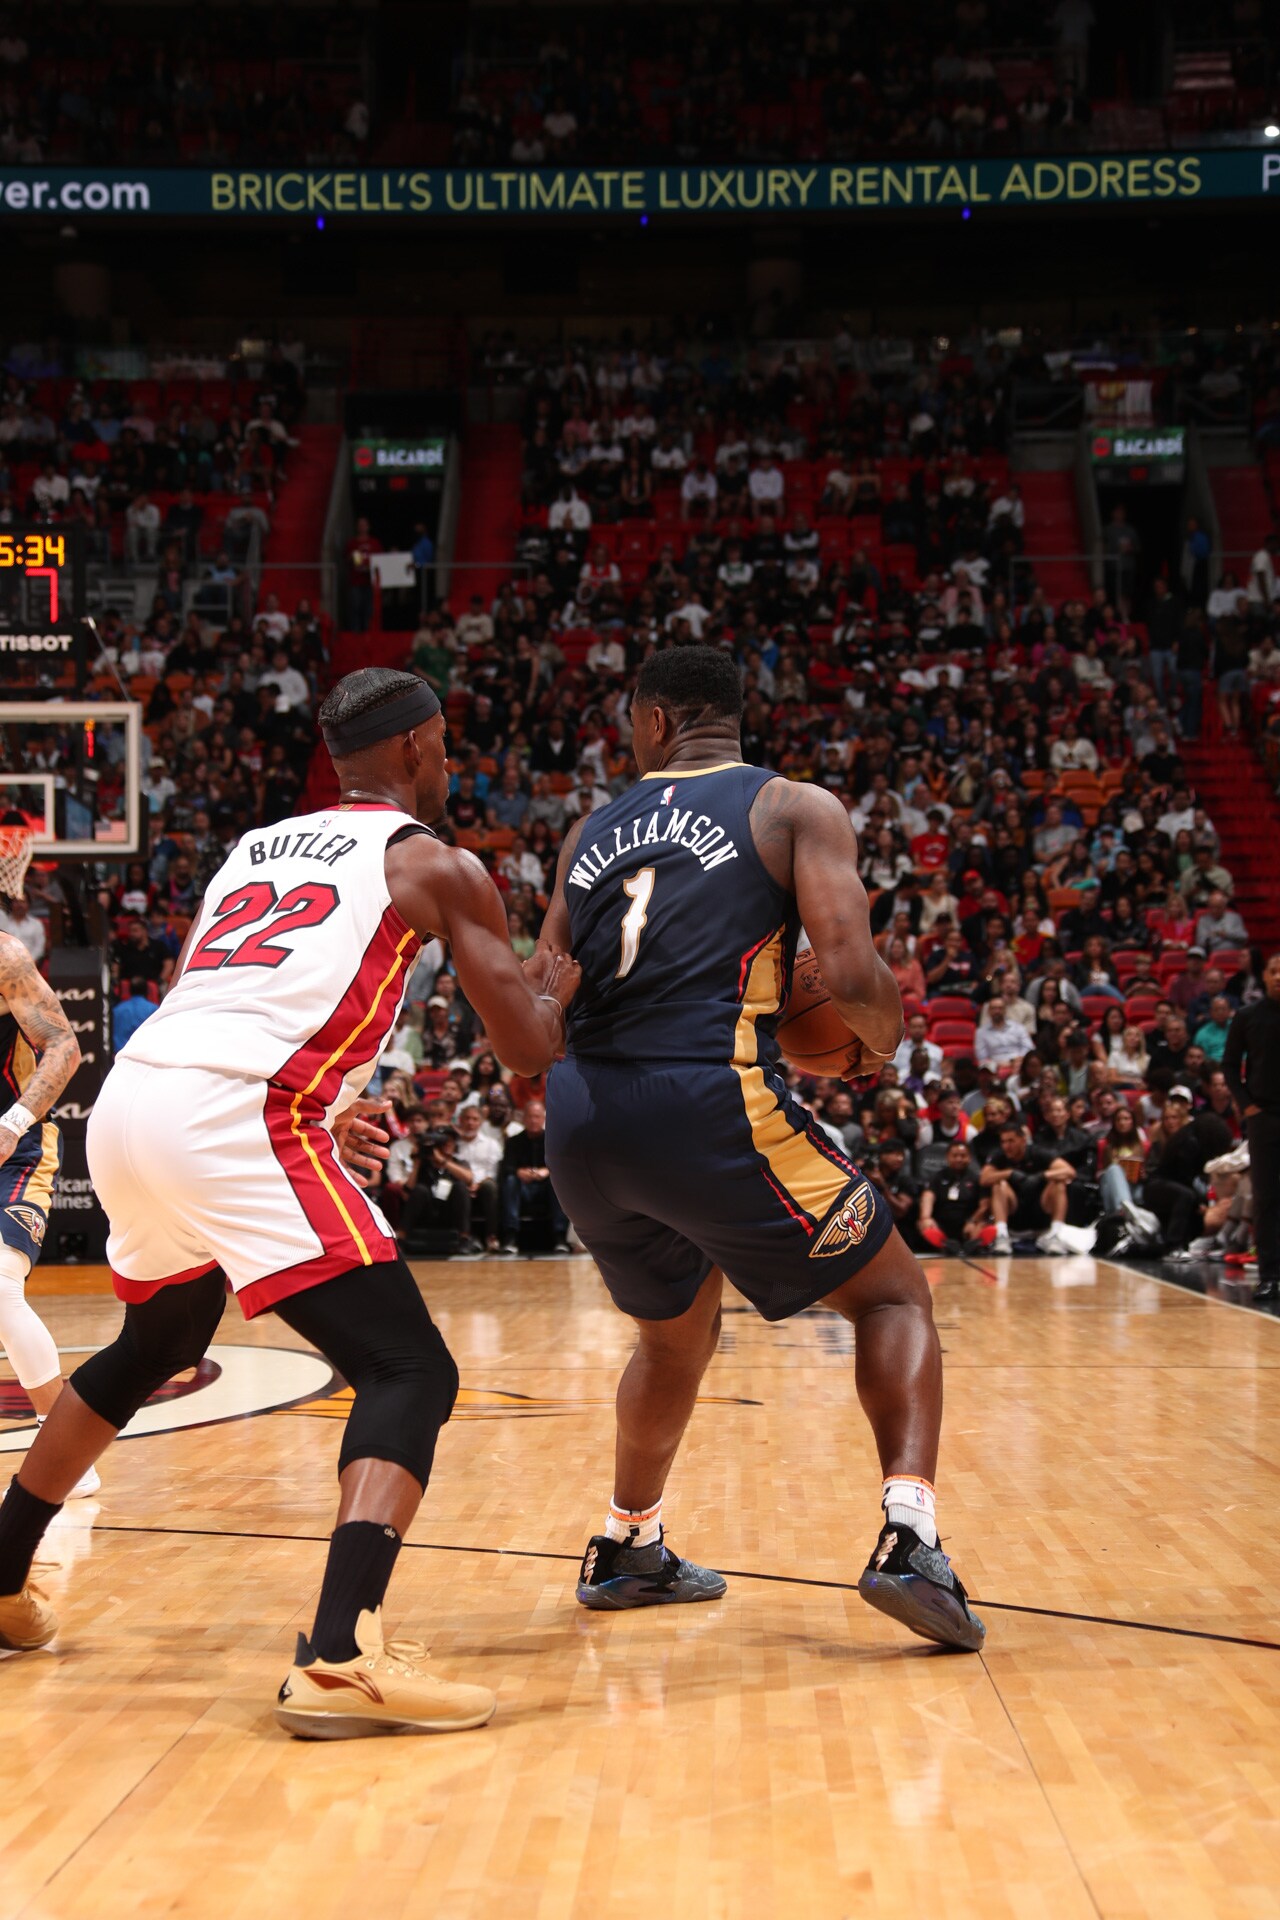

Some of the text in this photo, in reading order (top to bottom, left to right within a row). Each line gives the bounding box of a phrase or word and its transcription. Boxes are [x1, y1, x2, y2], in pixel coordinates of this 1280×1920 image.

[0, 180, 150, 210] er.com
[211, 157, 1202, 212] BRICKELL'S ULTIMATE LUXURY RENTAL ADDRESS
[1261, 153, 1280, 192] P
[0, 535, 65, 567] 5:34
[25, 567, 59, 624] 7
[0, 634, 73, 652] TISSOT
[249, 832, 358, 867] BUTLER
[568, 807, 739, 891] WILLIAMSON
[182, 881, 341, 977] 22
[614, 867, 656, 979] 1
